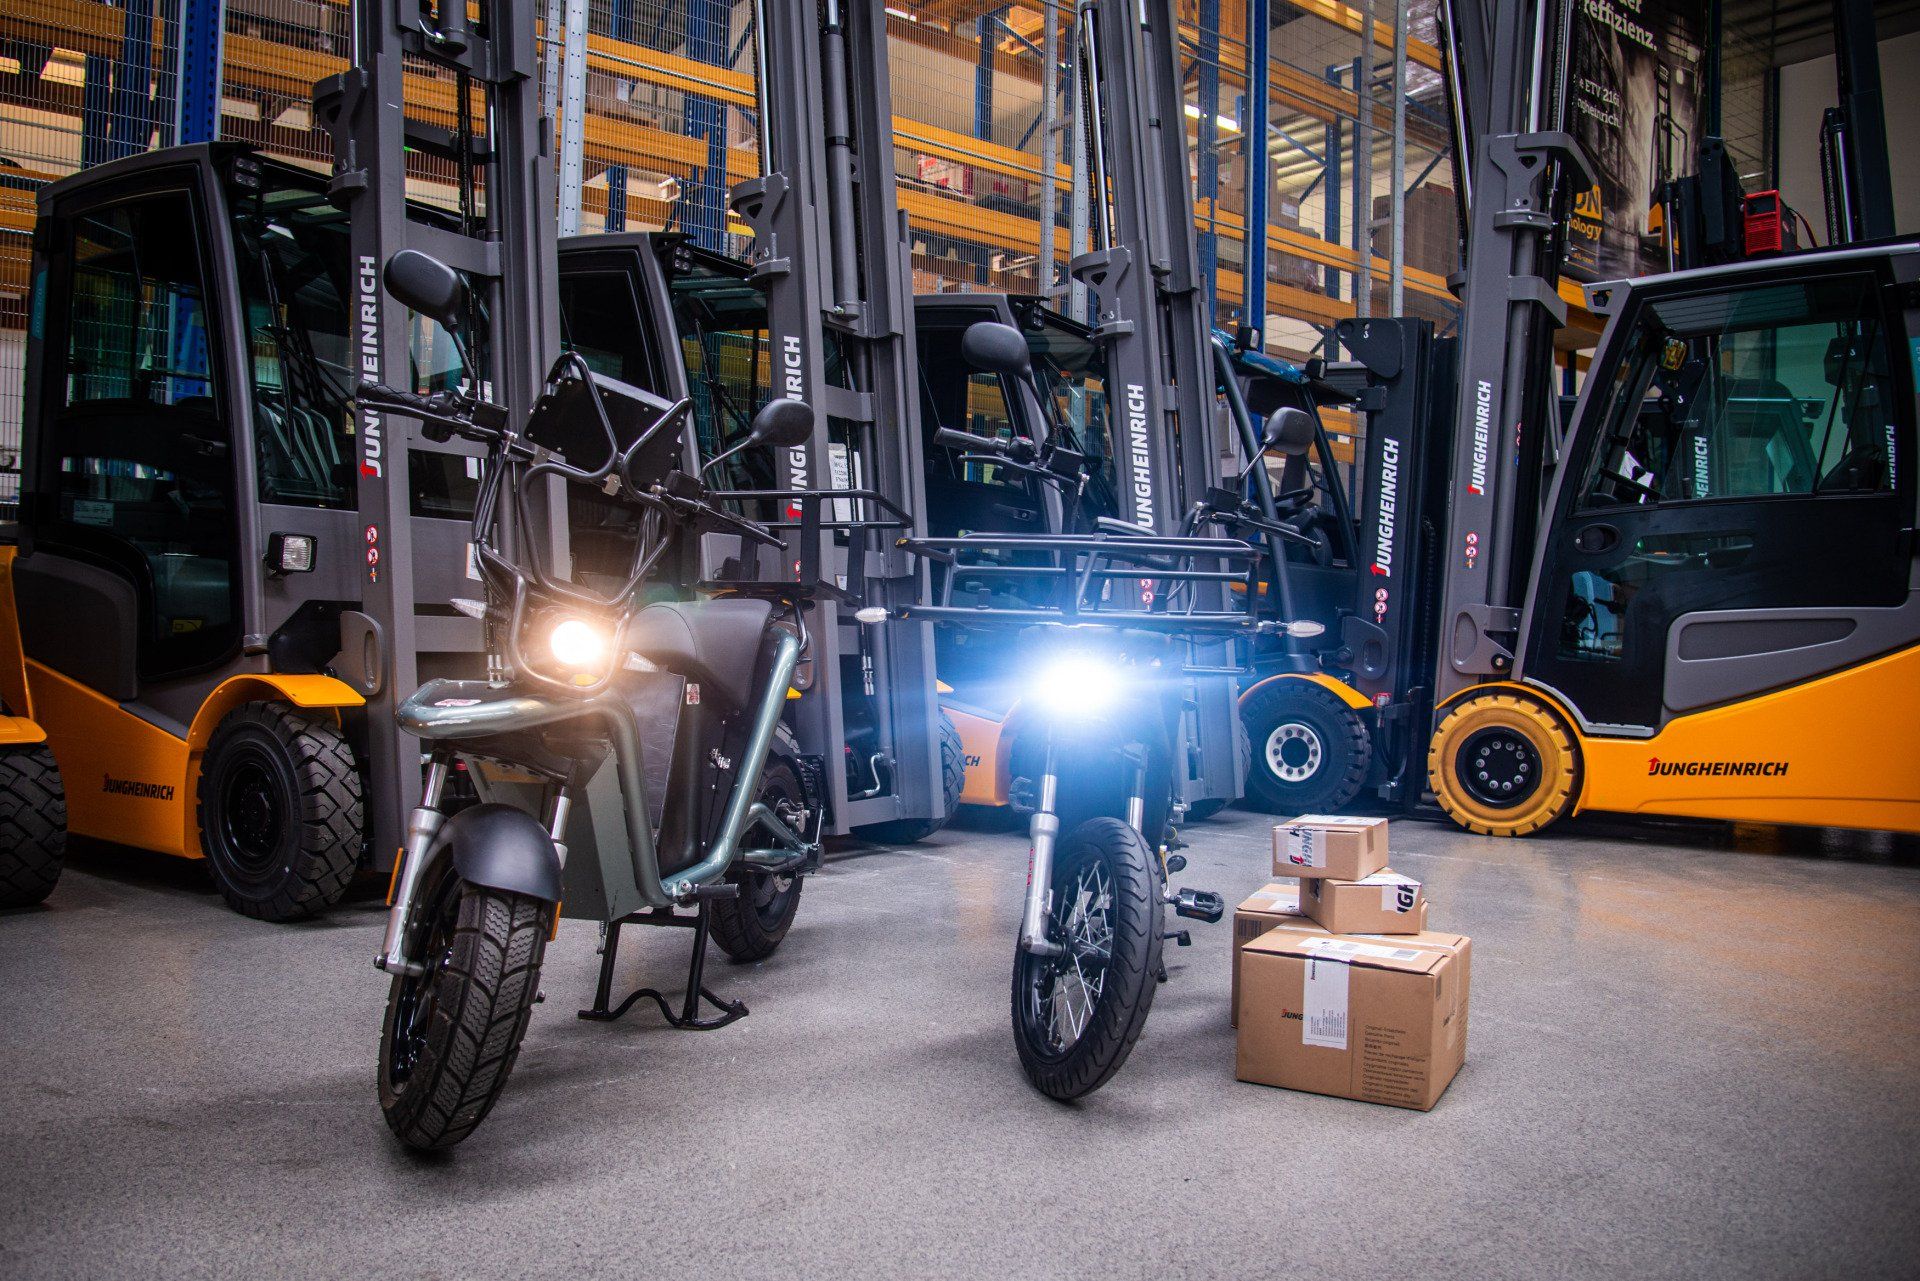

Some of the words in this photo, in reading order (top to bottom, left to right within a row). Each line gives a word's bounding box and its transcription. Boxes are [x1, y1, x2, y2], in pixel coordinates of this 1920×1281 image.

[360, 255, 382, 478] JUNEINRICH
[1127, 383, 1154, 528] UNGHEINRICH
[1467, 380, 1492, 496] JUNGHEINRICH
[1370, 437, 1399, 578] JUNGHEINRICH
[102, 773, 175, 801] JUNGHEINRICH
[1648, 756, 1789, 776] JUNGHEINRICH
